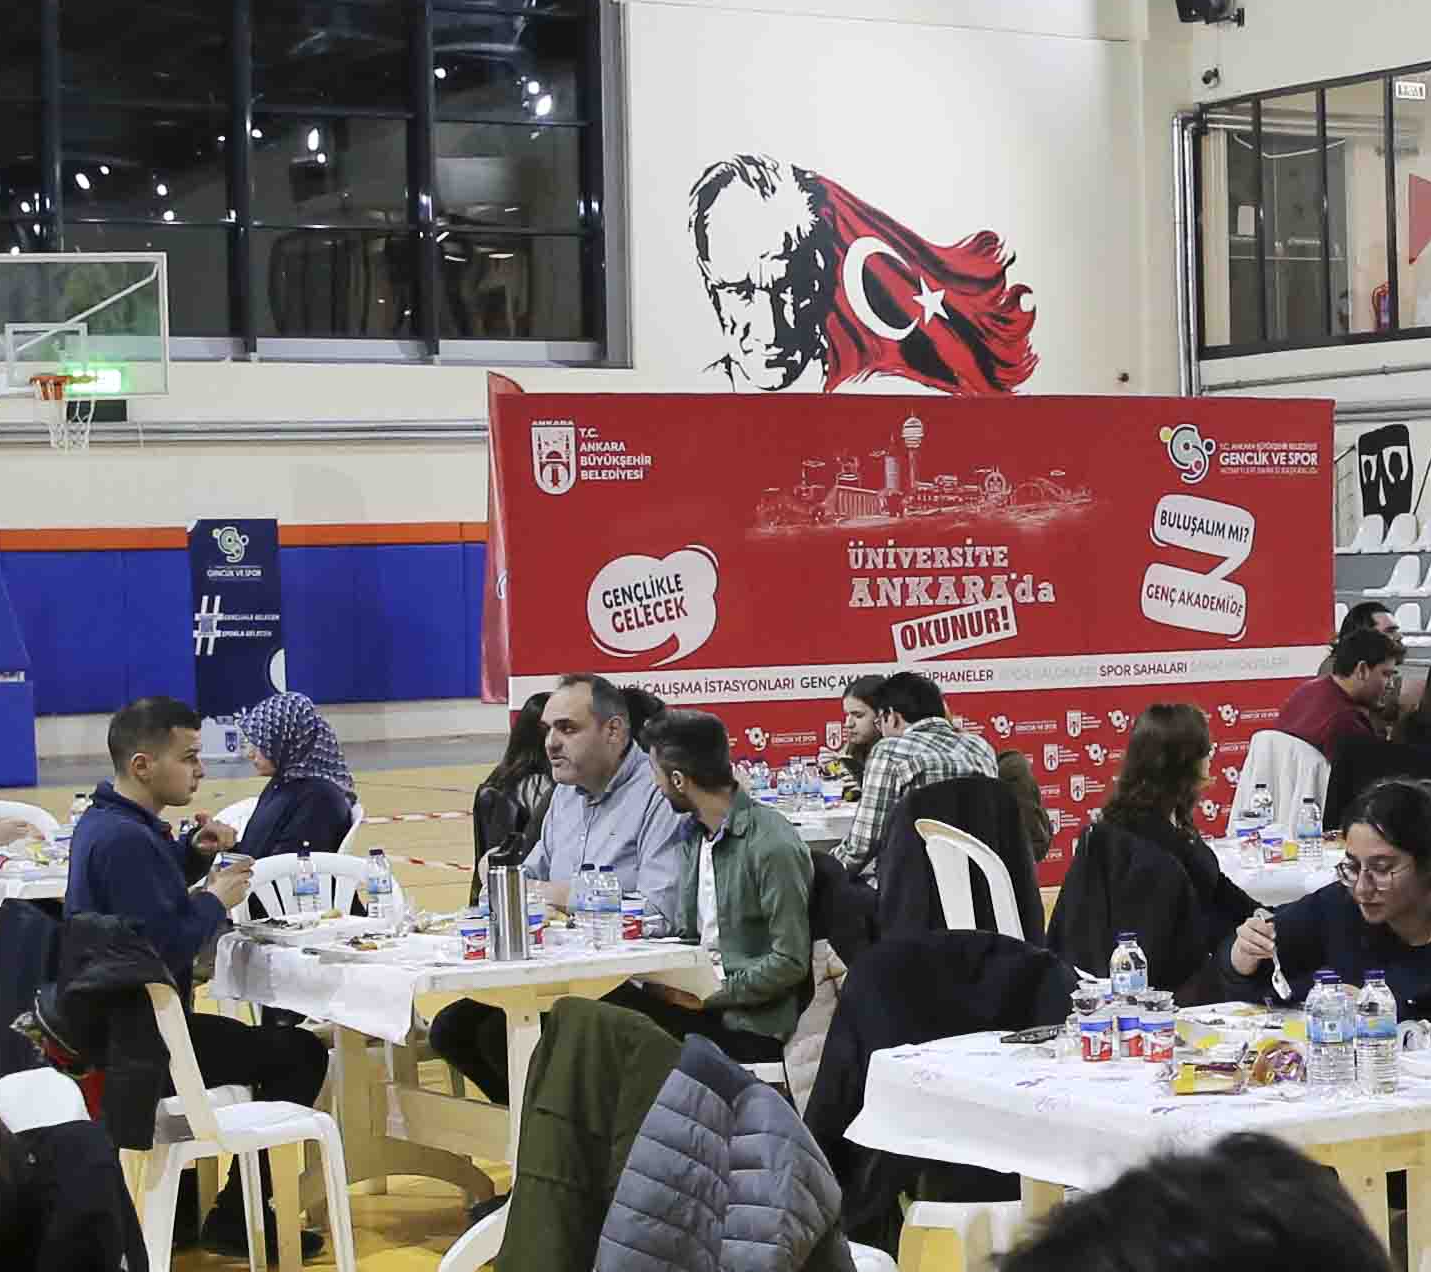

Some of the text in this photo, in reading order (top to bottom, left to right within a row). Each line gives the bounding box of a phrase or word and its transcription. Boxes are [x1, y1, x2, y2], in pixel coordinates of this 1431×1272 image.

[578, 428, 599, 438] T.C.
[579, 442, 625, 452] ANKARA
[1271, 452, 1287, 465] VE
[1289, 452, 1318, 465] SPOR
[580, 452, 652, 468] BÜYÜKŞEHİR
[580, 467, 644, 480] BELEDİYESİ
[1160, 509, 1249, 543] BULUŞALIM MI?
[847, 537, 1009, 569] ÜNİVERSİTE
[602, 573, 684, 609] GENÇLİKLE
[848, 572, 1056, 607] ANKARA'da
[1146, 583, 1244, 617] GENÇ AKADEMİ'DE
[611, 595, 689, 633] GELECEK
[900, 605, 1010, 651] OKUNUR!
[1099, 664, 1131, 677] SPOR
[1133, 662, 1188, 676] SAHALARI
[704, 677, 794, 694] İSTASYONLARI
[800, 676, 836, 691] GENÇ
